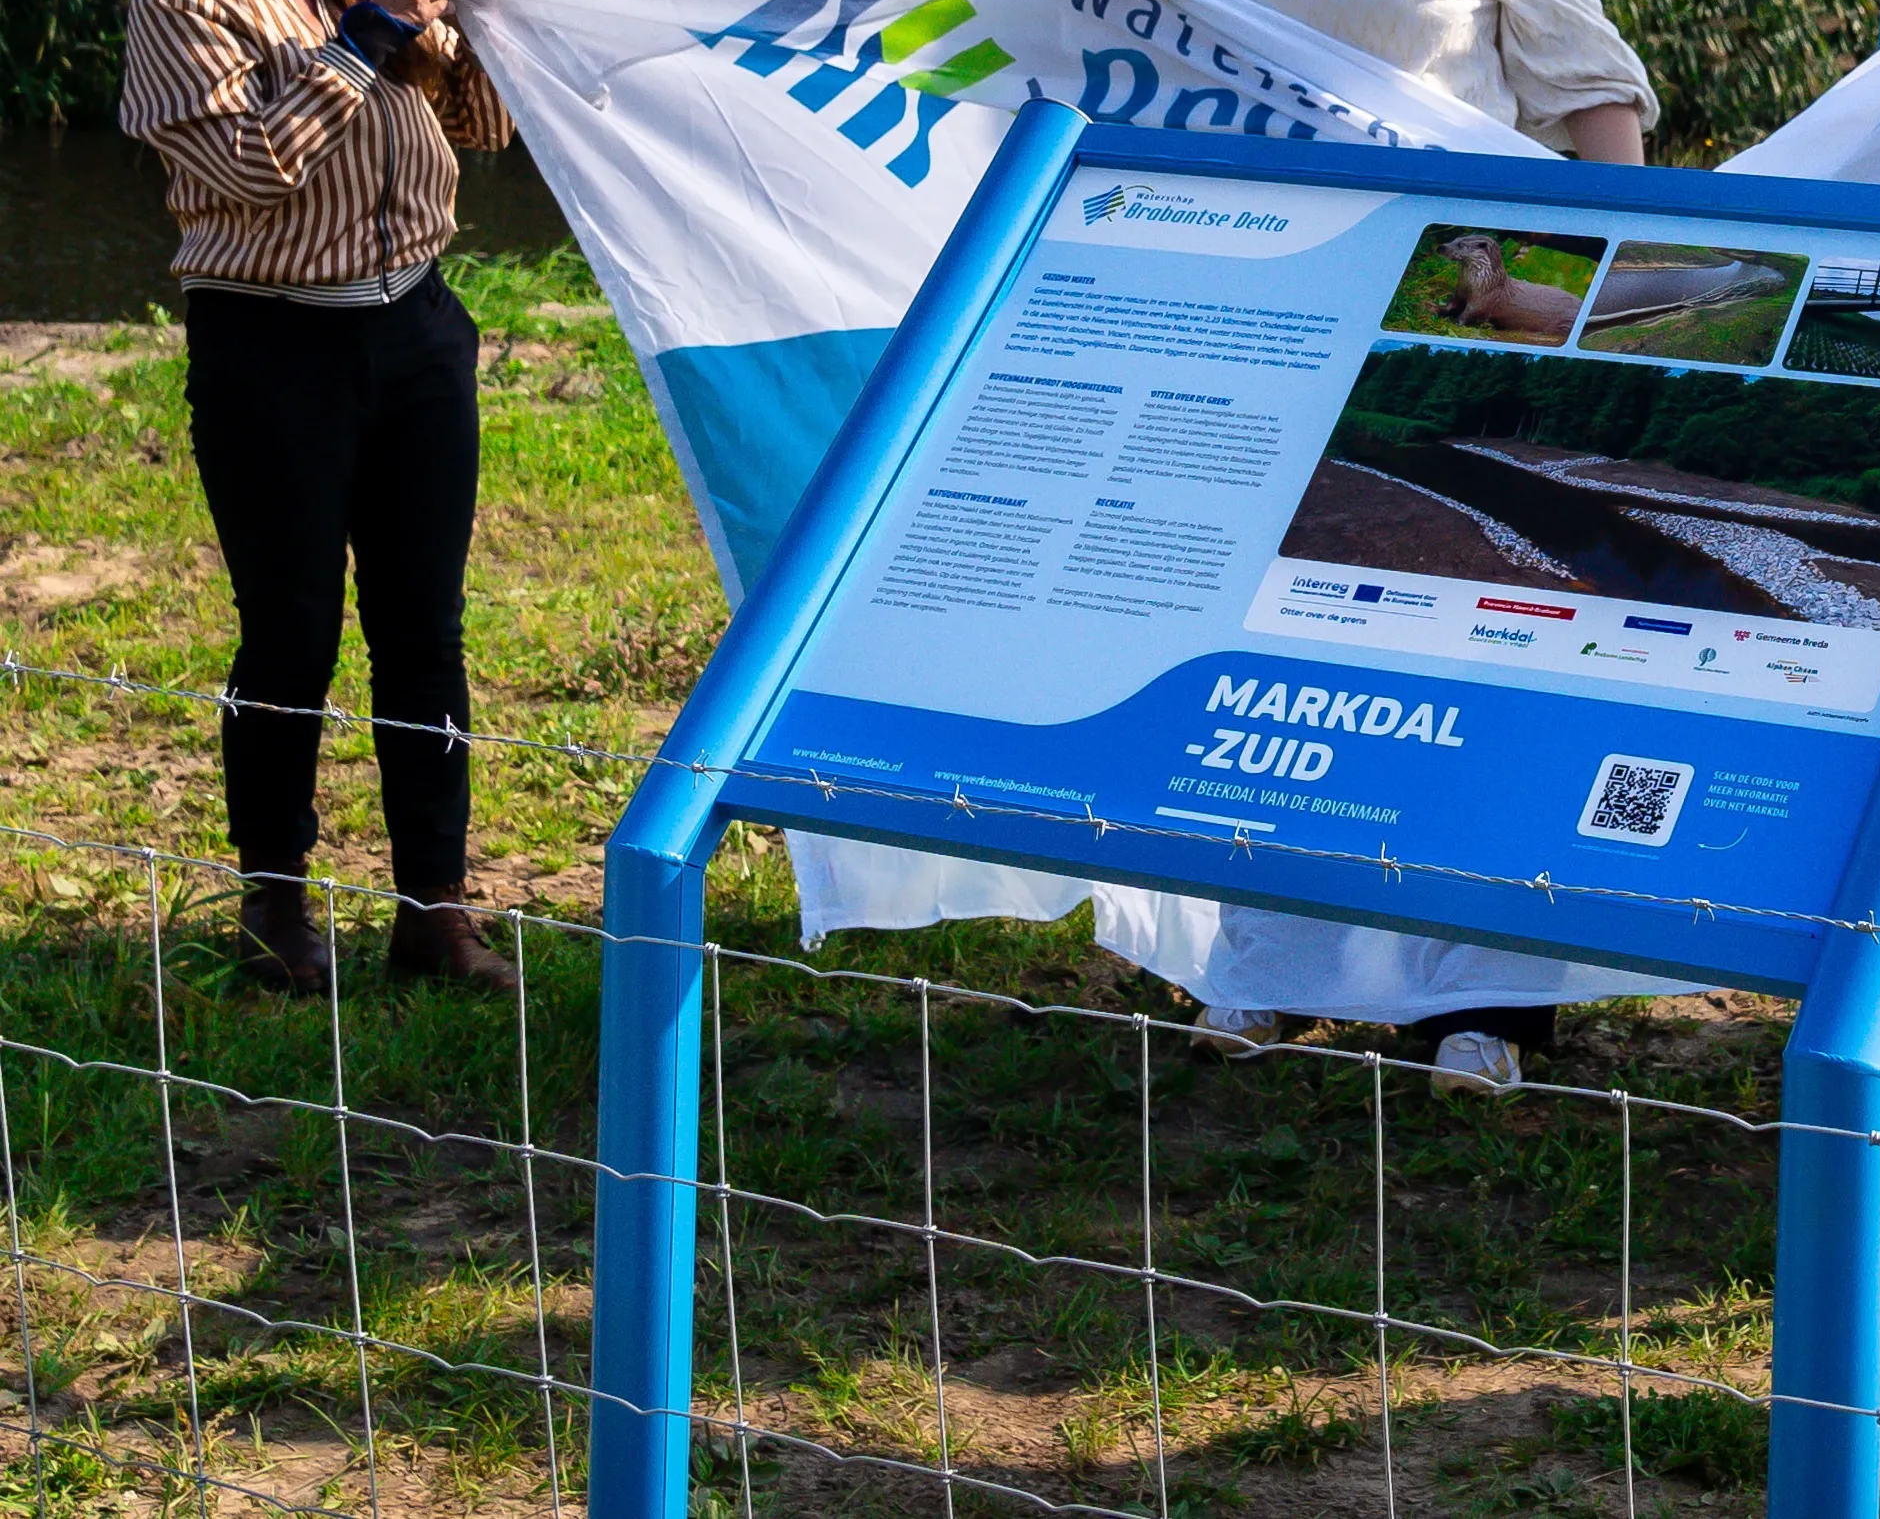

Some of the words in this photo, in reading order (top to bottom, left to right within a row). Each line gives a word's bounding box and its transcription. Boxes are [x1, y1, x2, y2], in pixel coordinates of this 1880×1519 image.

[1136, 192, 1195, 205] Waterschap
[1124, 201, 1230, 228] Brabantse
[1233, 211, 1289, 233] Delta
[1041, 273, 1071, 281] GEZOND
[1071, 275, 1097, 284] WATER
[1175, 393, 1195, 401] OVER
[1095, 498, 1135, 509] RECREATIE
[1292, 576, 1350, 594] Interreg
[1280, 607, 1304, 618] Otter
[1306, 610, 1326, 620] over
[1327, 612, 1340, 621] de
[1340, 615, 1367, 626] grens
[1470, 623, 1534, 644] Markdal
[1756, 632, 1801, 645] Gemeente
[1802, 638, 1829, 649] Breda
[1204, 674, 1464, 747] MARKDAL
[791, 747, 904, 772] www.brabantsedelta.nl
[1184, 727, 1334, 781] -ZUID
[933, 769, 1096, 804] www.werkenbijbrabantsedelta.nl
[1712, 770, 1737, 782] SCAN
[1737, 773, 1750, 784] DE
[1750, 775, 1774, 787] CODE
[1774, 779, 1800, 791] VOOR
[1167, 775, 1197, 793] HET
[1195, 779, 1256, 802] BEEKDAL
[1259, 788, 1289, 807] VAN
[1288, 793, 1311, 810] DE
[1309, 797, 1401, 825] BOVENMARK
[1707, 783, 1734, 795] MEER
[1733, 788, 1789, 804] INFORMATIE
[1702, 796, 1728, 808] OVER
[1727, 800, 1747, 811] HET
[1746, 803, 1790, 819] MARKDAL
